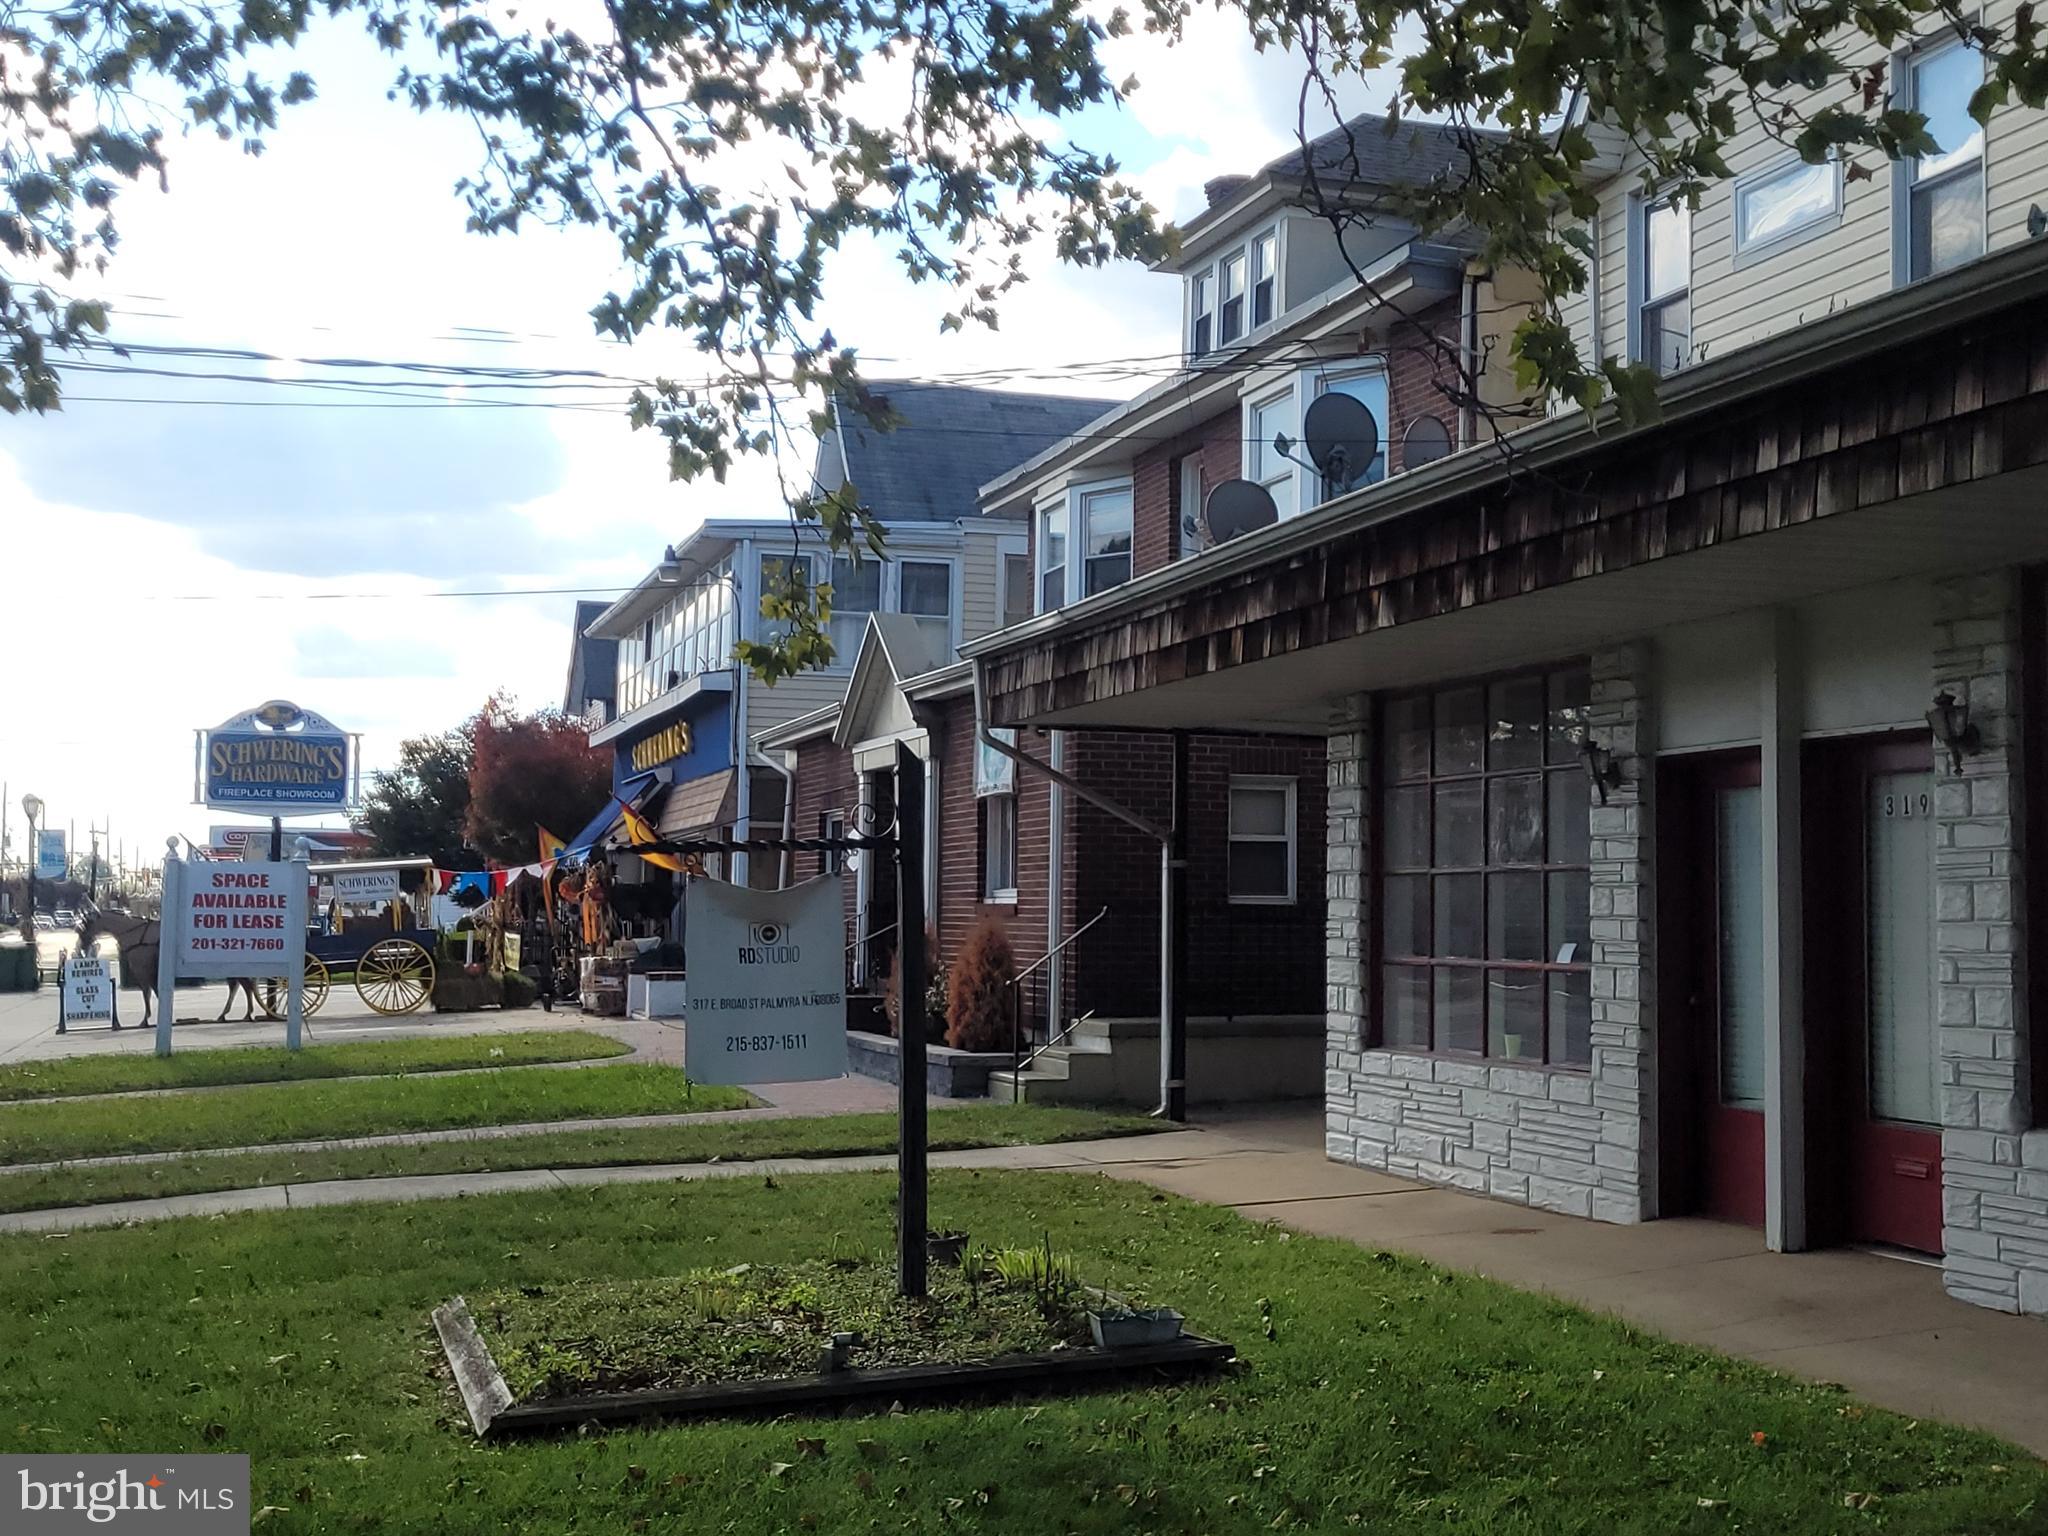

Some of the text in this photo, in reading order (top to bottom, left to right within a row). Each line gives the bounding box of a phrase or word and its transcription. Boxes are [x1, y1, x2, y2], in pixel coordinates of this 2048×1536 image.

[211, 738, 343, 780] SCHWERING'S
[231, 764, 323, 784] HARDWARE
[218, 788, 335, 799] FIREPLACE SHOWROOM
[1886, 794, 1928, 816] 319
[212, 873, 270, 888] SPACE
[338, 875, 395, 889] SCHWERING'S
[192, 893, 287, 909] AVAILABLE
[193, 914, 285, 929] FOR LEASE
[191, 937, 285, 951] 201-321-7660
[739, 945, 801, 964] RDSTUDIO
[693, 998, 709, 1010] 317
[720, 998, 748, 1010] BROAD
[749, 998, 758, 1009] ST
[760, 996, 801, 1009] PALMYRA
[726, 1034, 807, 1051] 215-837-1511
